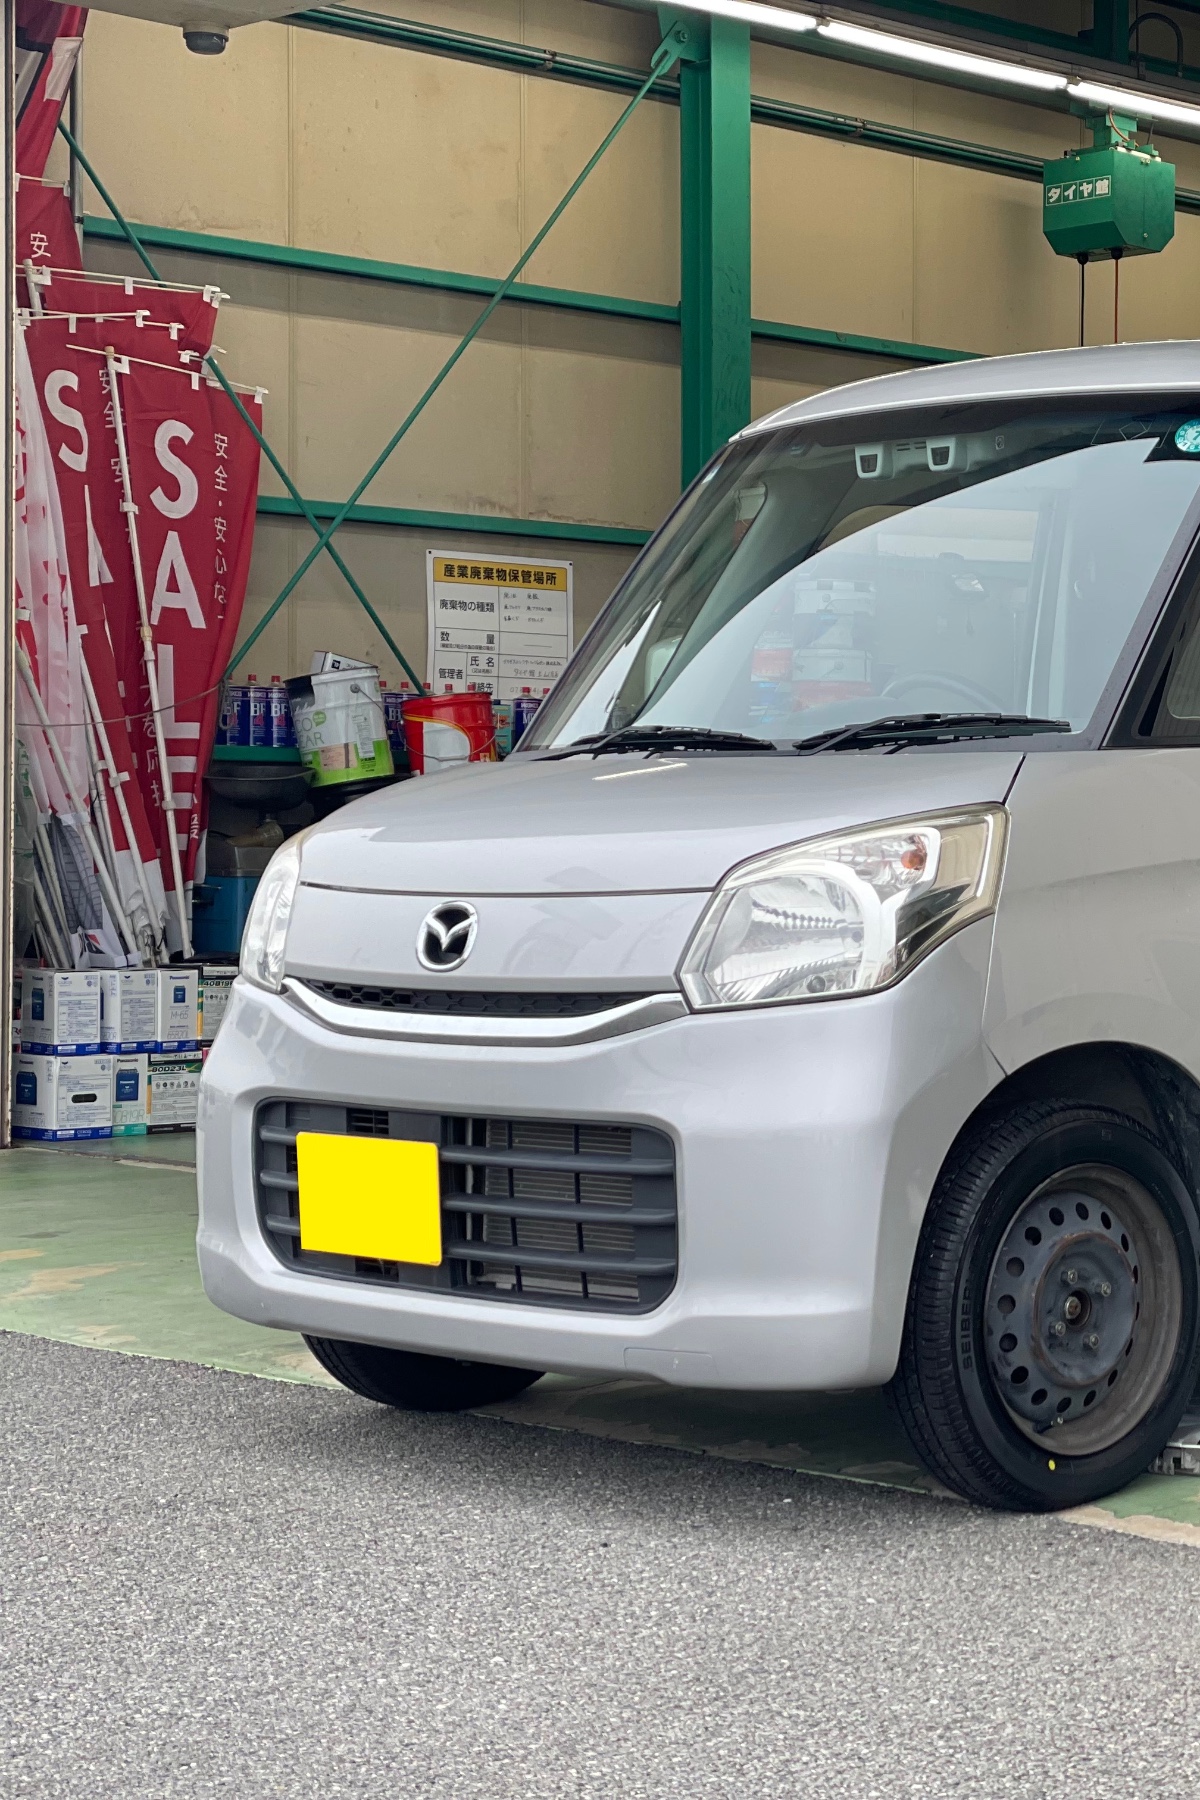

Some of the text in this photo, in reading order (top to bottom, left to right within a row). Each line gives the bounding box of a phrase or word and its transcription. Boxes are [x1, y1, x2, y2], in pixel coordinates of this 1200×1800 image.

[1047, 178, 1110, 203] タイヤ館
[443, 563, 557, 586] 産業廃棄物保管場所
[439, 598, 495, 614] 廃棄物の種類
[440, 631, 495, 645] 数 量
[469, 656, 495, 667] 氏 名
[438, 667, 464, 680] 管理者
[250, 702, 266, 716] BF
[270, 703, 288, 717] BF
